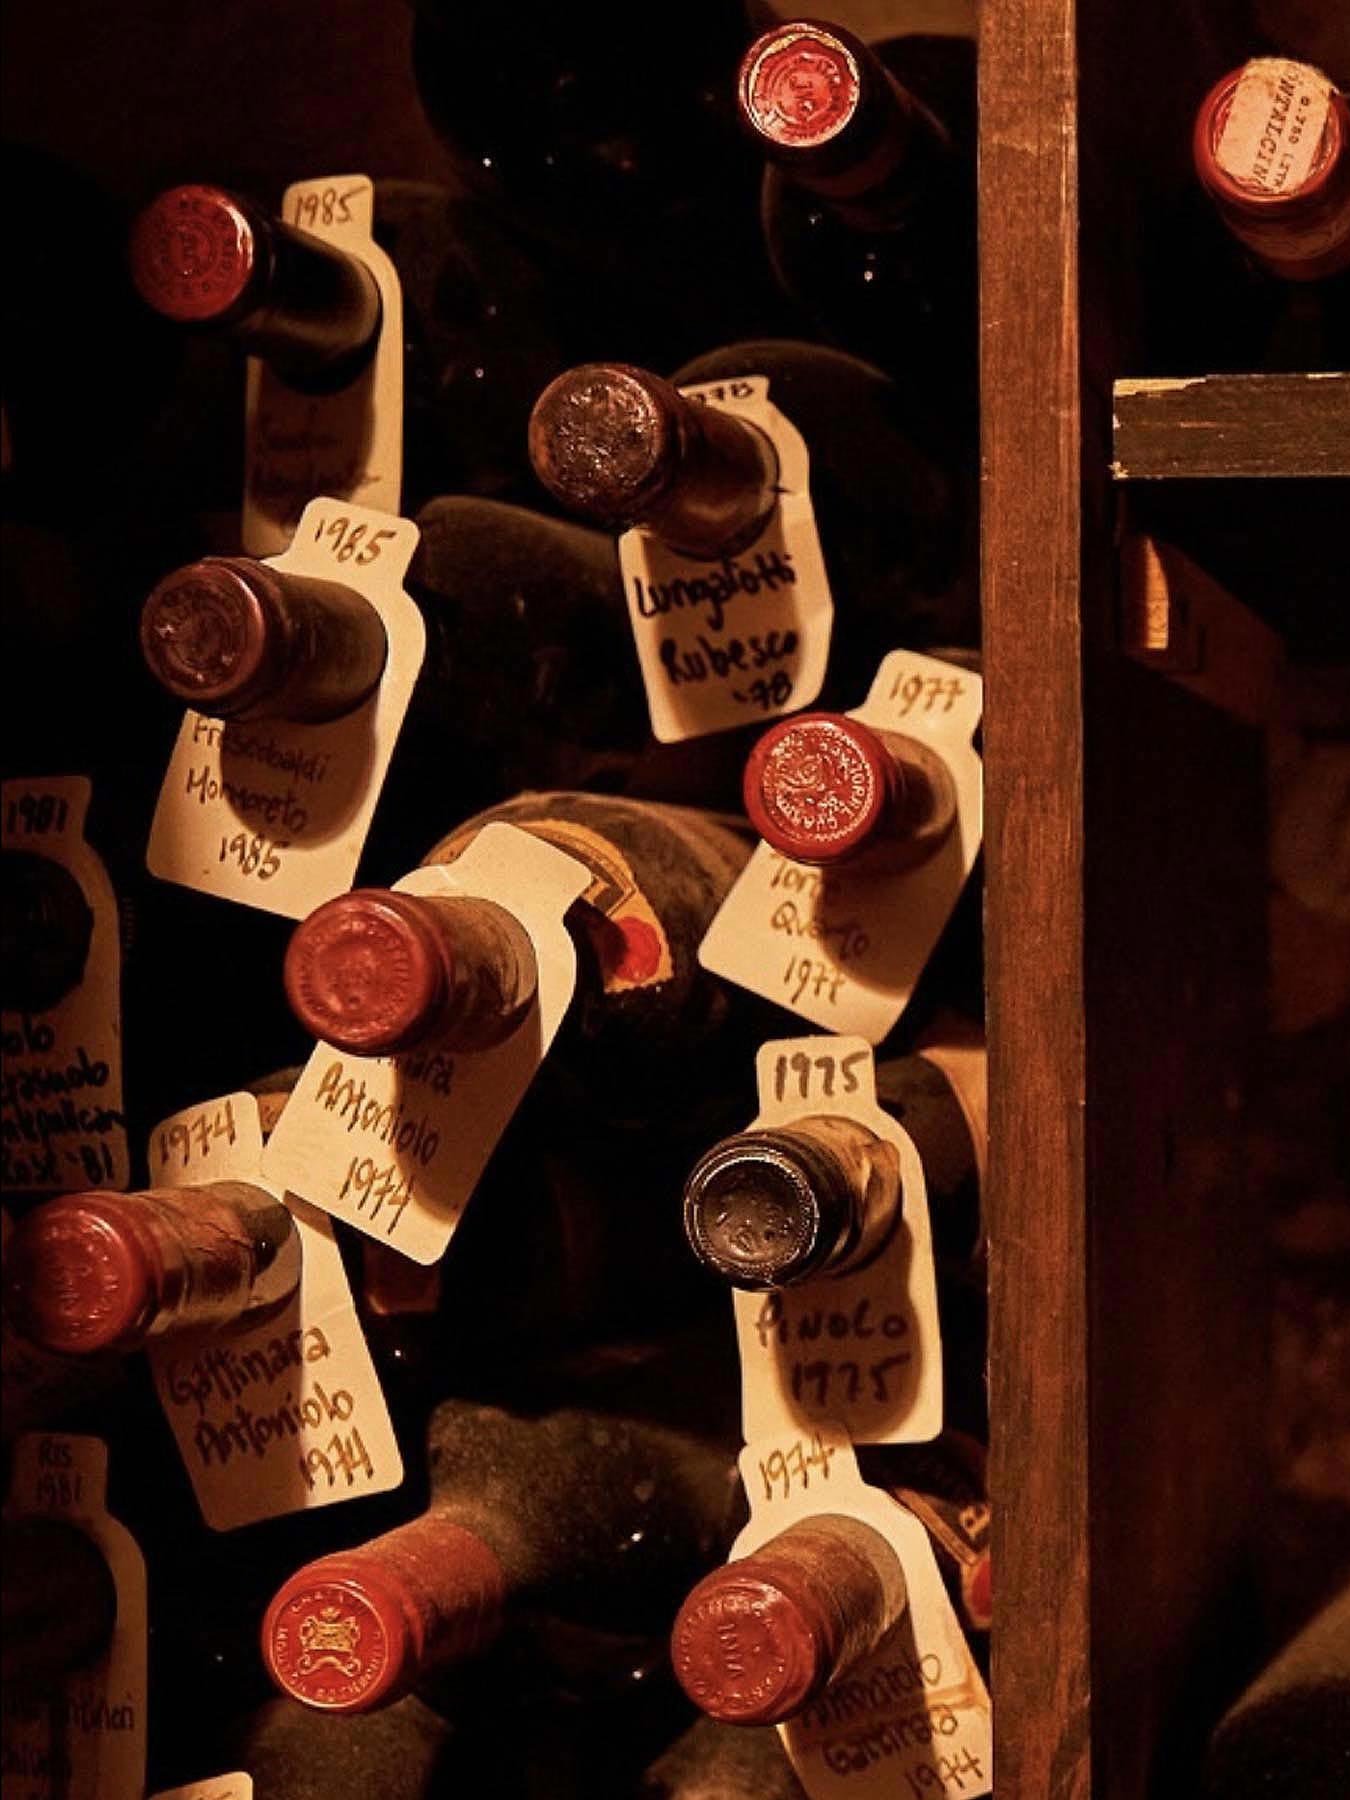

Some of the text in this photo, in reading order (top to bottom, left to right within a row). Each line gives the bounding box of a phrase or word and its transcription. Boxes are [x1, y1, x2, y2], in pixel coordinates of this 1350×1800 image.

[295, 186, 369, 228] 1985
[314, 516, 398, 566] 1985
[889, 672, 966, 717] 1977
[7, 793, 68, 835] 1981
[219, 832, 291, 881] 1985
[783, 956, 847, 1006] 1977
[774, 1051, 870, 1102] 1975
[160, 1099, 236, 1167] 1974
[339, 1156, 415, 1236] 1974
[791, 1352, 912, 1408] 1975
[299, 1426, 374, 1492] 1974
[759, 1432, 836, 1501] 1974
